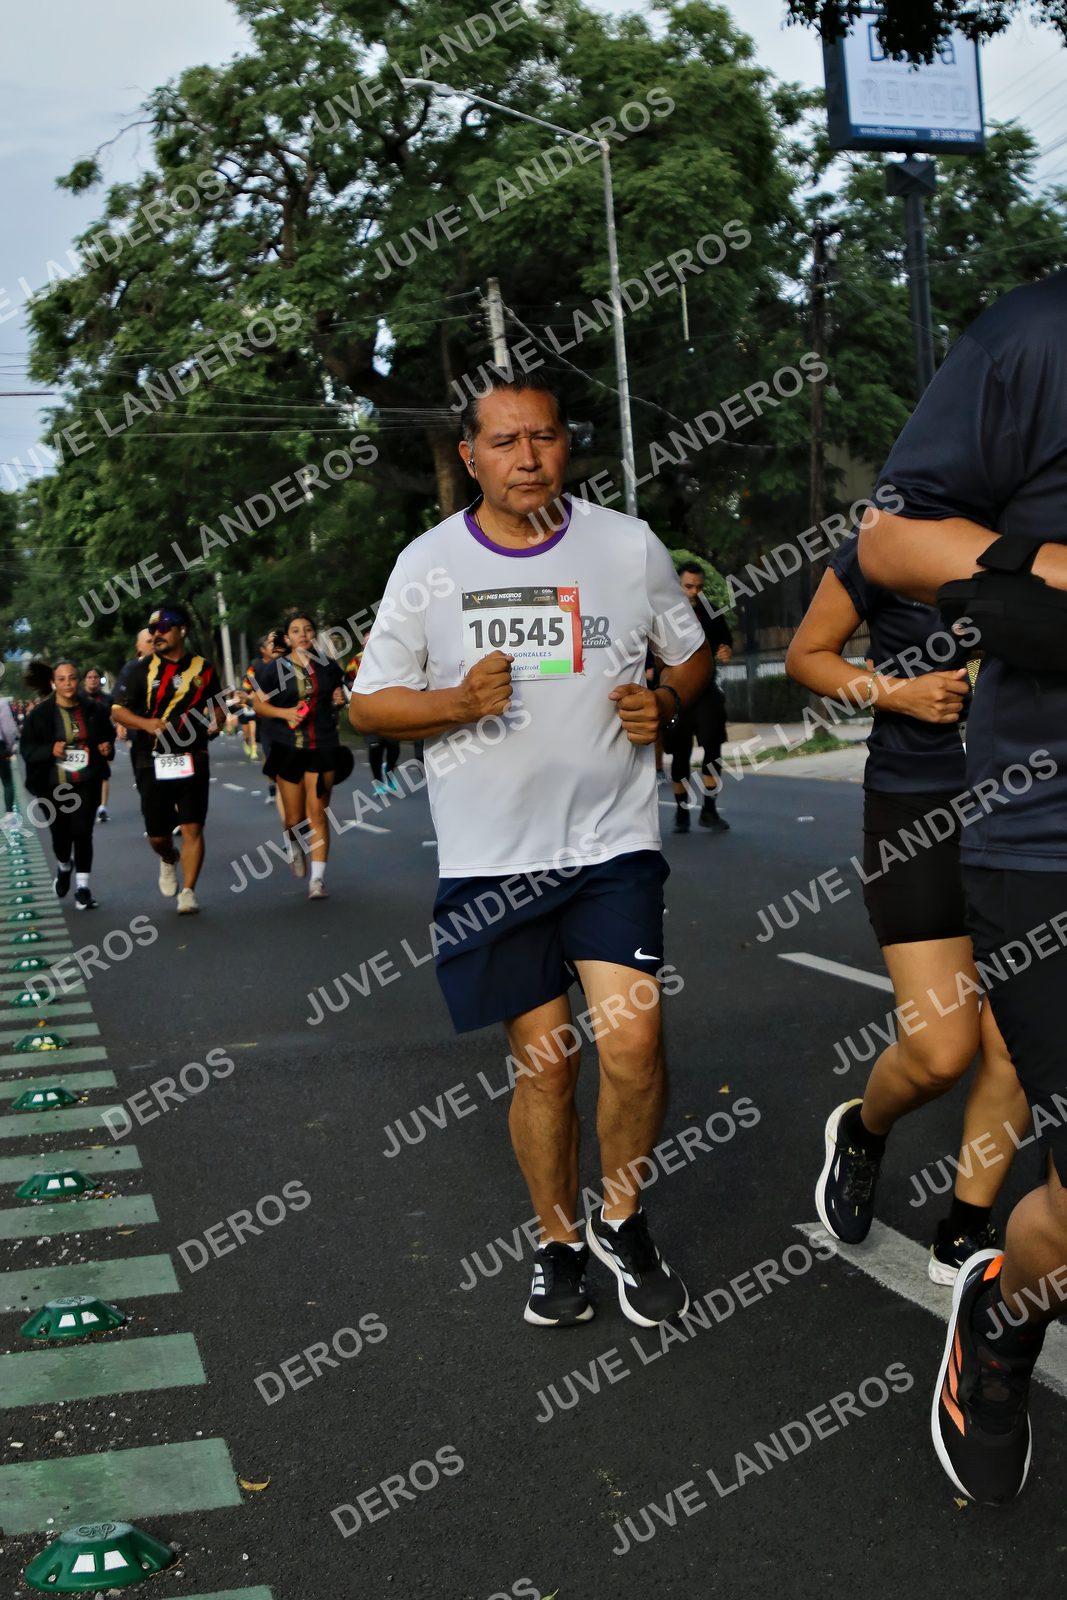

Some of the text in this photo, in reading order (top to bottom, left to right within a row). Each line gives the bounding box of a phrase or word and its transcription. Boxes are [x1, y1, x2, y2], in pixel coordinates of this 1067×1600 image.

[560, 594, 575, 603] 10K
[468, 616, 565, 649] 10545
[160, 757, 185, 768] 9998
